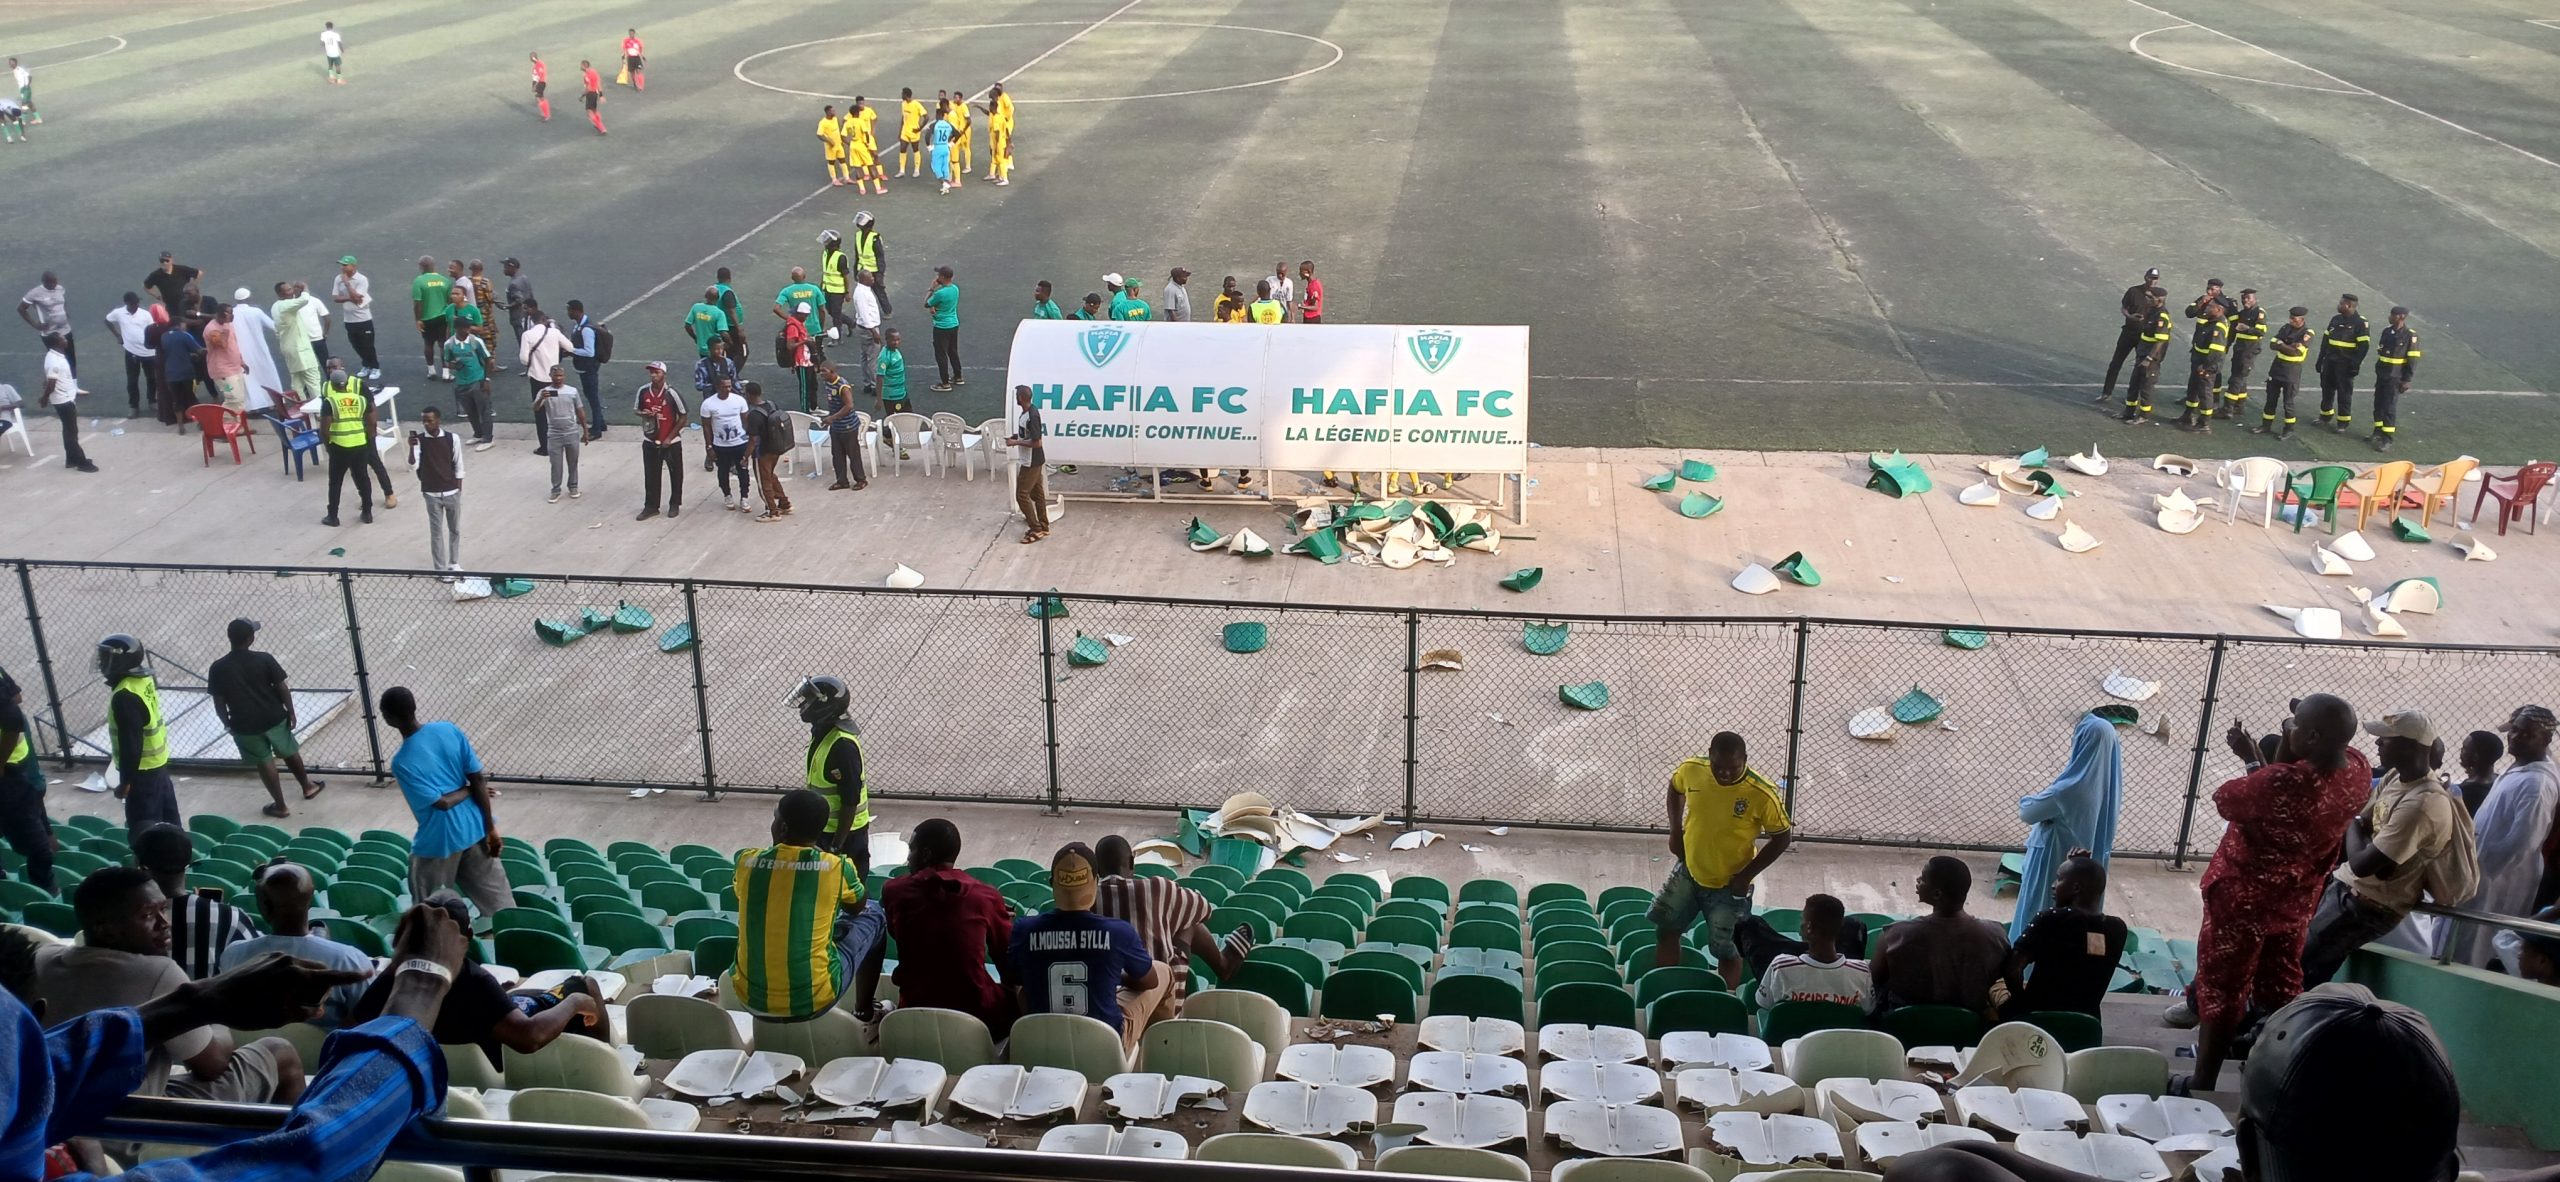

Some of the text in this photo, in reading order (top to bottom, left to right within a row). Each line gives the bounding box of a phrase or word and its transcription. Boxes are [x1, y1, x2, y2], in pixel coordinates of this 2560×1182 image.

[939, 130, 948, 142] 16
[793, 290, 812, 298] STAFF
[1032, 384, 1248, 414] HAFIA FC
[1292, 387, 1514, 417] HAFIA FC
[1145, 425, 1258, 440] CONTINUE...
[1285, 425, 1523, 445] LA LÉGENDE CONTINUE...
[1029, 930, 1111, 951] M.MOUSSA SYLLA
[1048, 961, 1088, 1015] 6
[2030, 1041, 2045, 1057] 216
[2037, 1036, 2043, 1044] B
